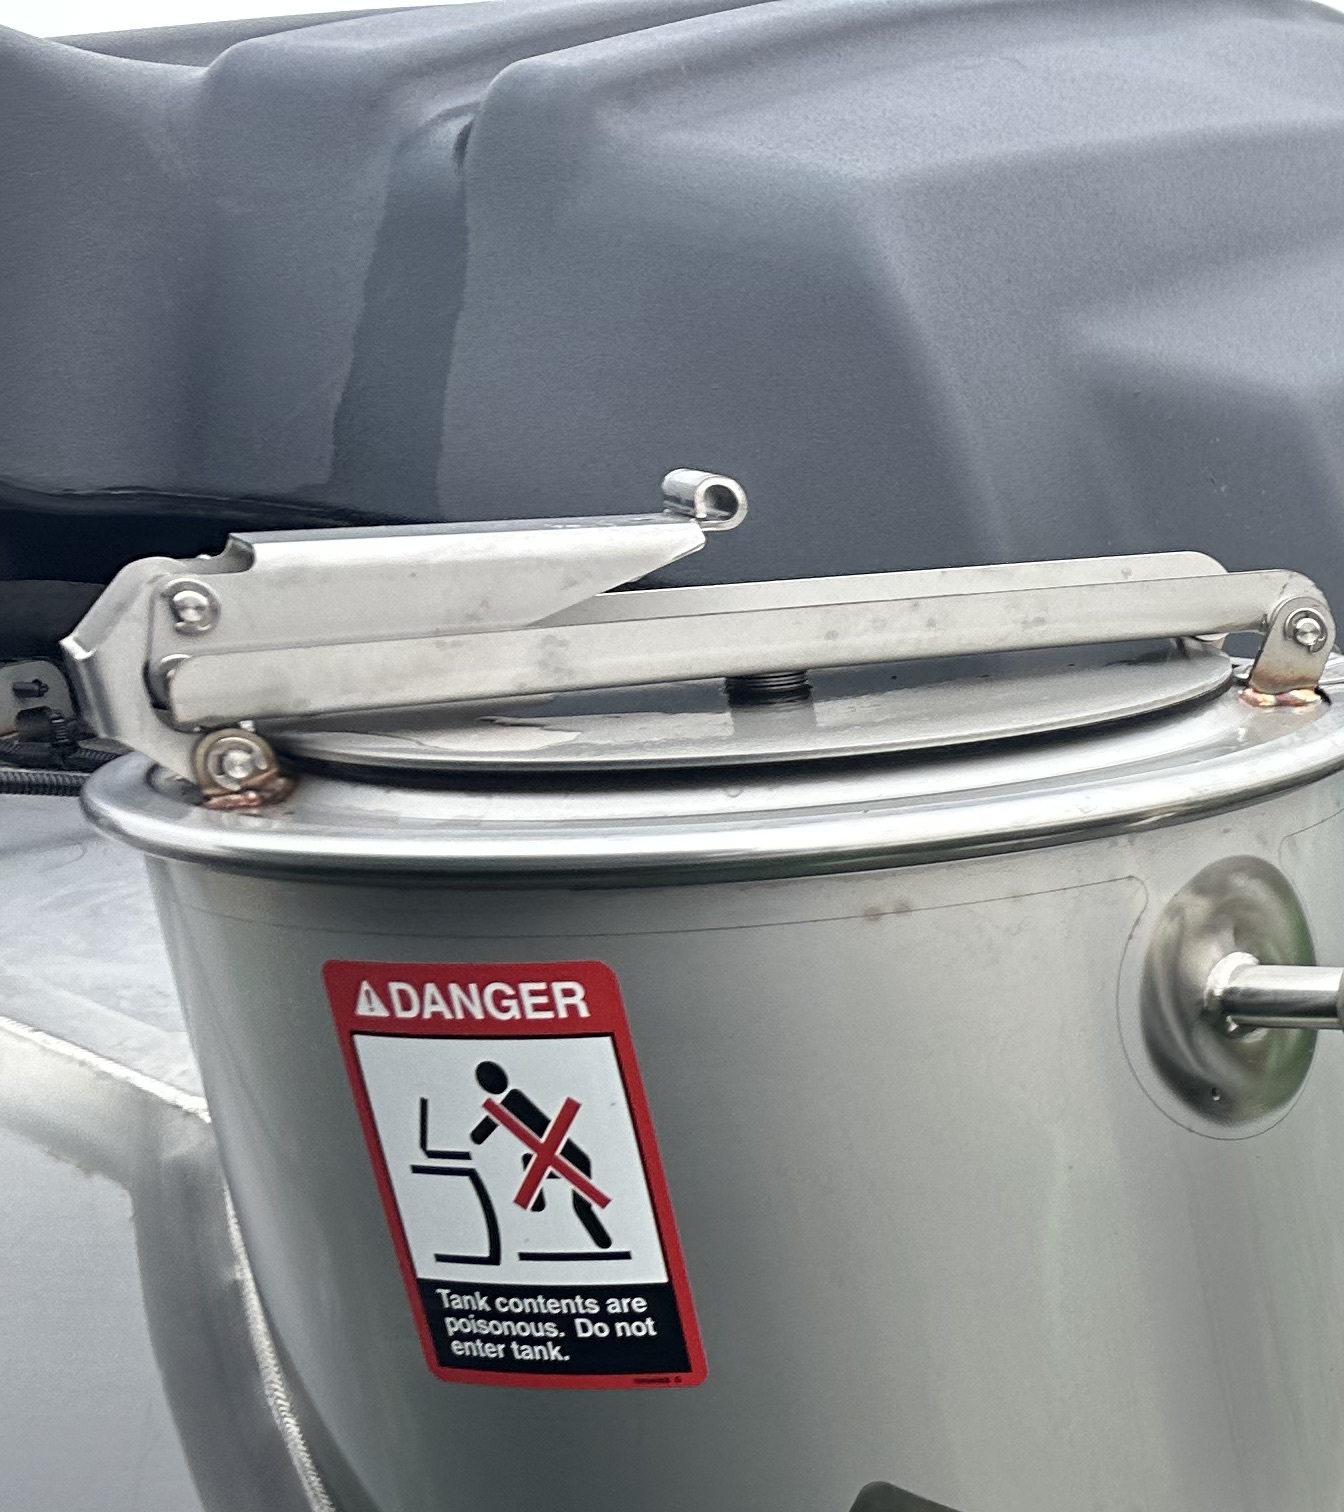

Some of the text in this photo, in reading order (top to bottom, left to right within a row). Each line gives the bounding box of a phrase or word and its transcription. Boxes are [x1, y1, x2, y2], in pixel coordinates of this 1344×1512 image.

[388, 981, 591, 1020] DANGER
[437, 1289, 648, 1314] Tank contents are
[445, 1314, 657, 1338] poisonous. Do not
[451, 1340, 570, 1362] enter tank.
